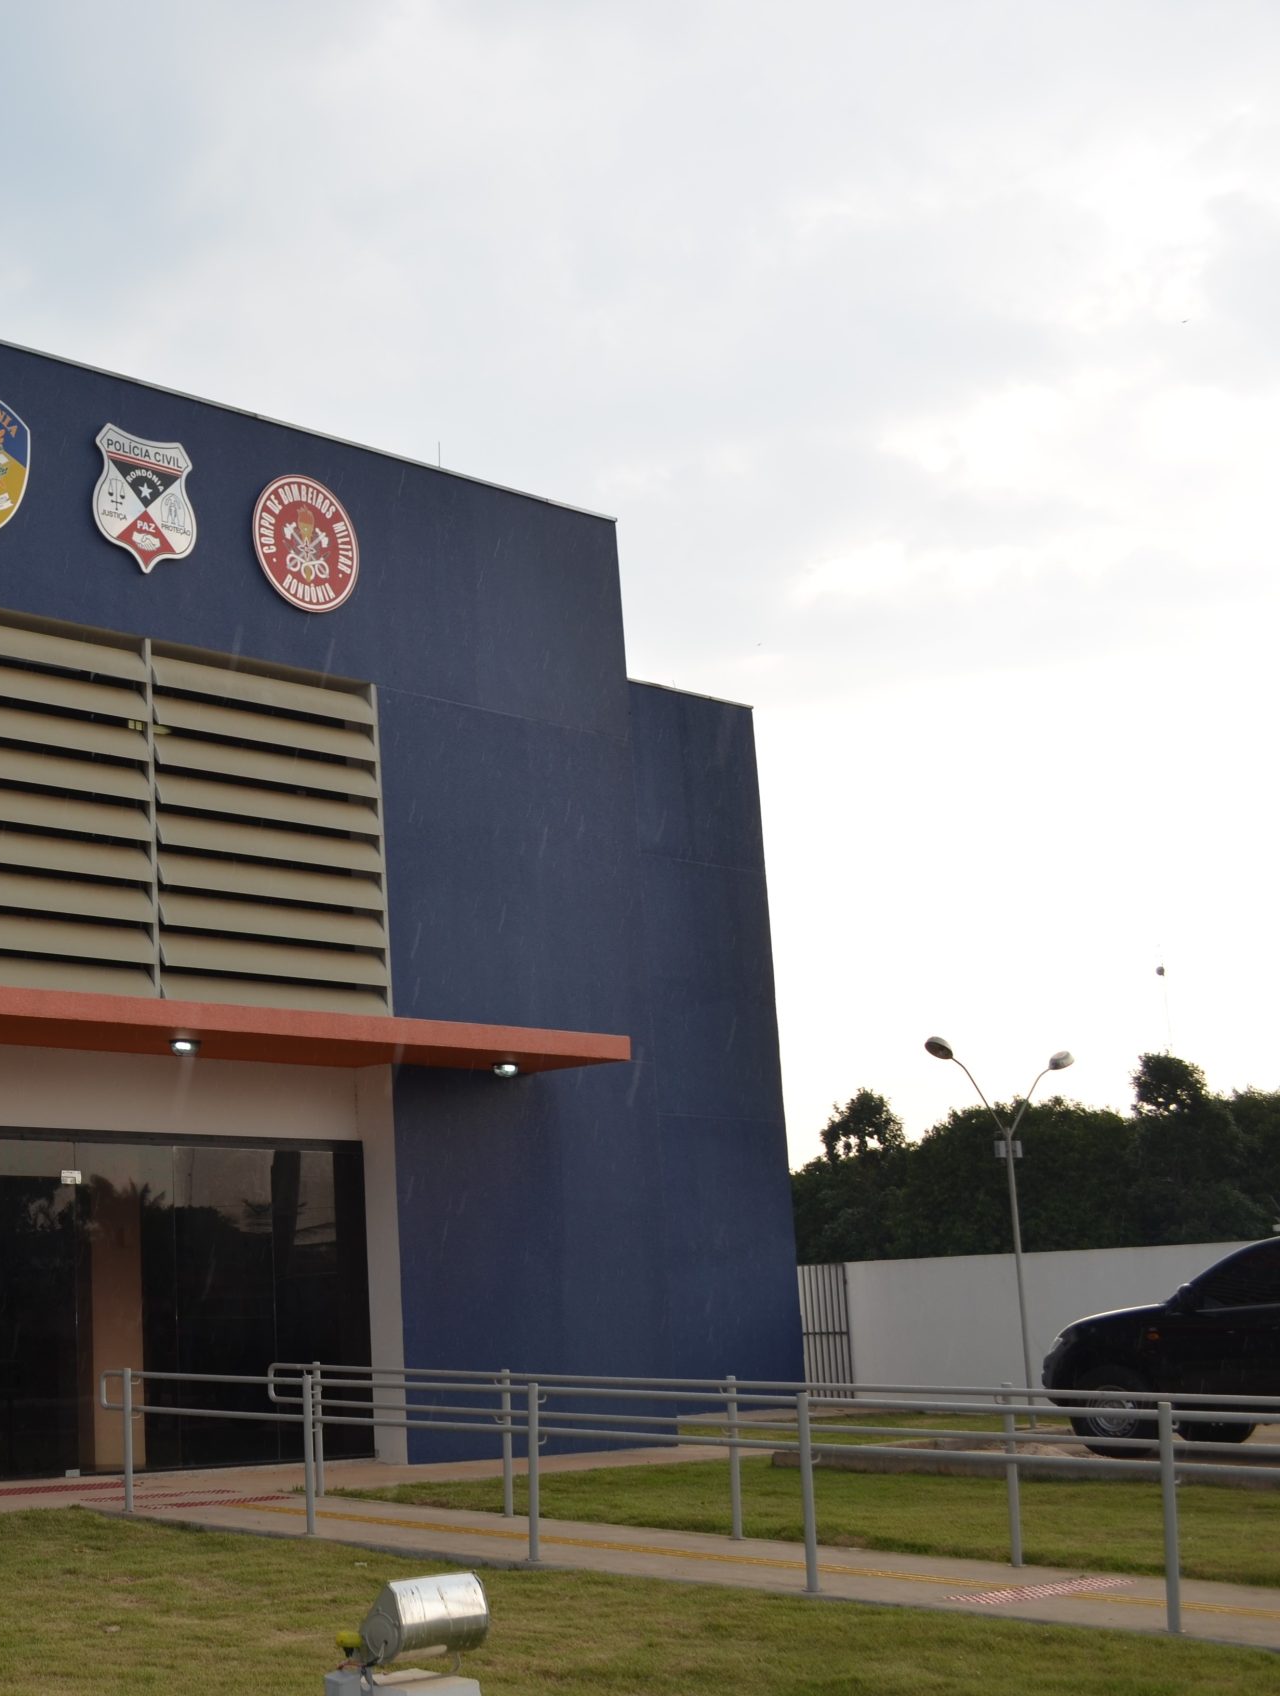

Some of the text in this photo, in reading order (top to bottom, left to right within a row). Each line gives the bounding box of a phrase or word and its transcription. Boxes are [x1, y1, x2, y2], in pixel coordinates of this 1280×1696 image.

[106, 438, 182, 469] POLÍCIA CIVIL
[126, 469, 164, 492] RONDÔNIA
[136, 520, 156, 532] PAZ
[260, 484, 352, 574] CORPO DE BOMBEIROS MILITAR
[282, 574, 336, 603] RONDÔNIA
